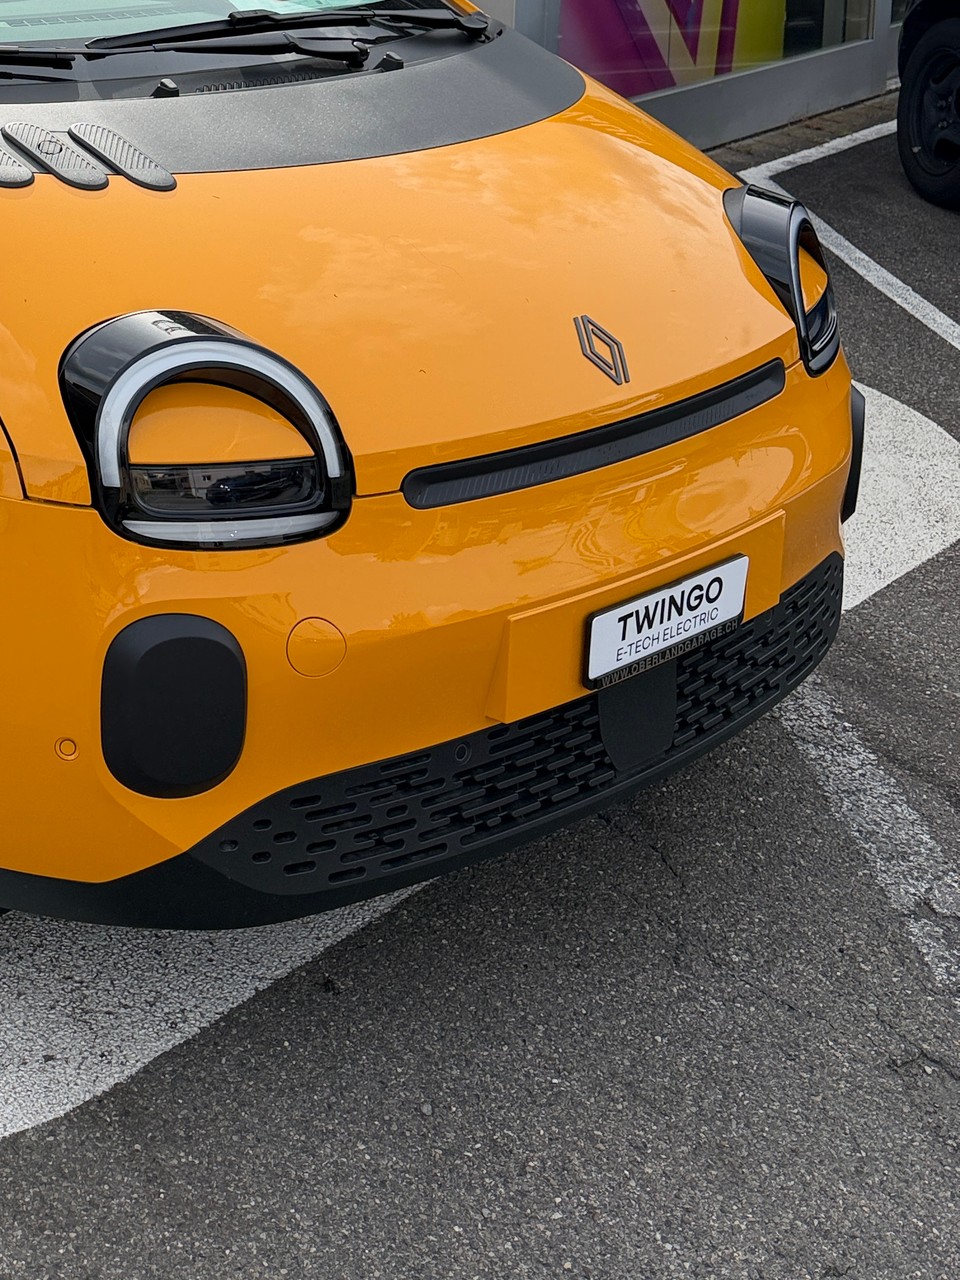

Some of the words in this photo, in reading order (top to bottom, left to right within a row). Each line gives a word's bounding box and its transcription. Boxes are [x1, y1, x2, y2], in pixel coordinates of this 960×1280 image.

[615, 630, 660, 663] E-TECH
[662, 607, 719, 643] ELECTRIC
[617, 576, 724, 642] TWINGO
[601, 620, 738, 687] WWW.OBERLANDGARAGE.CH
